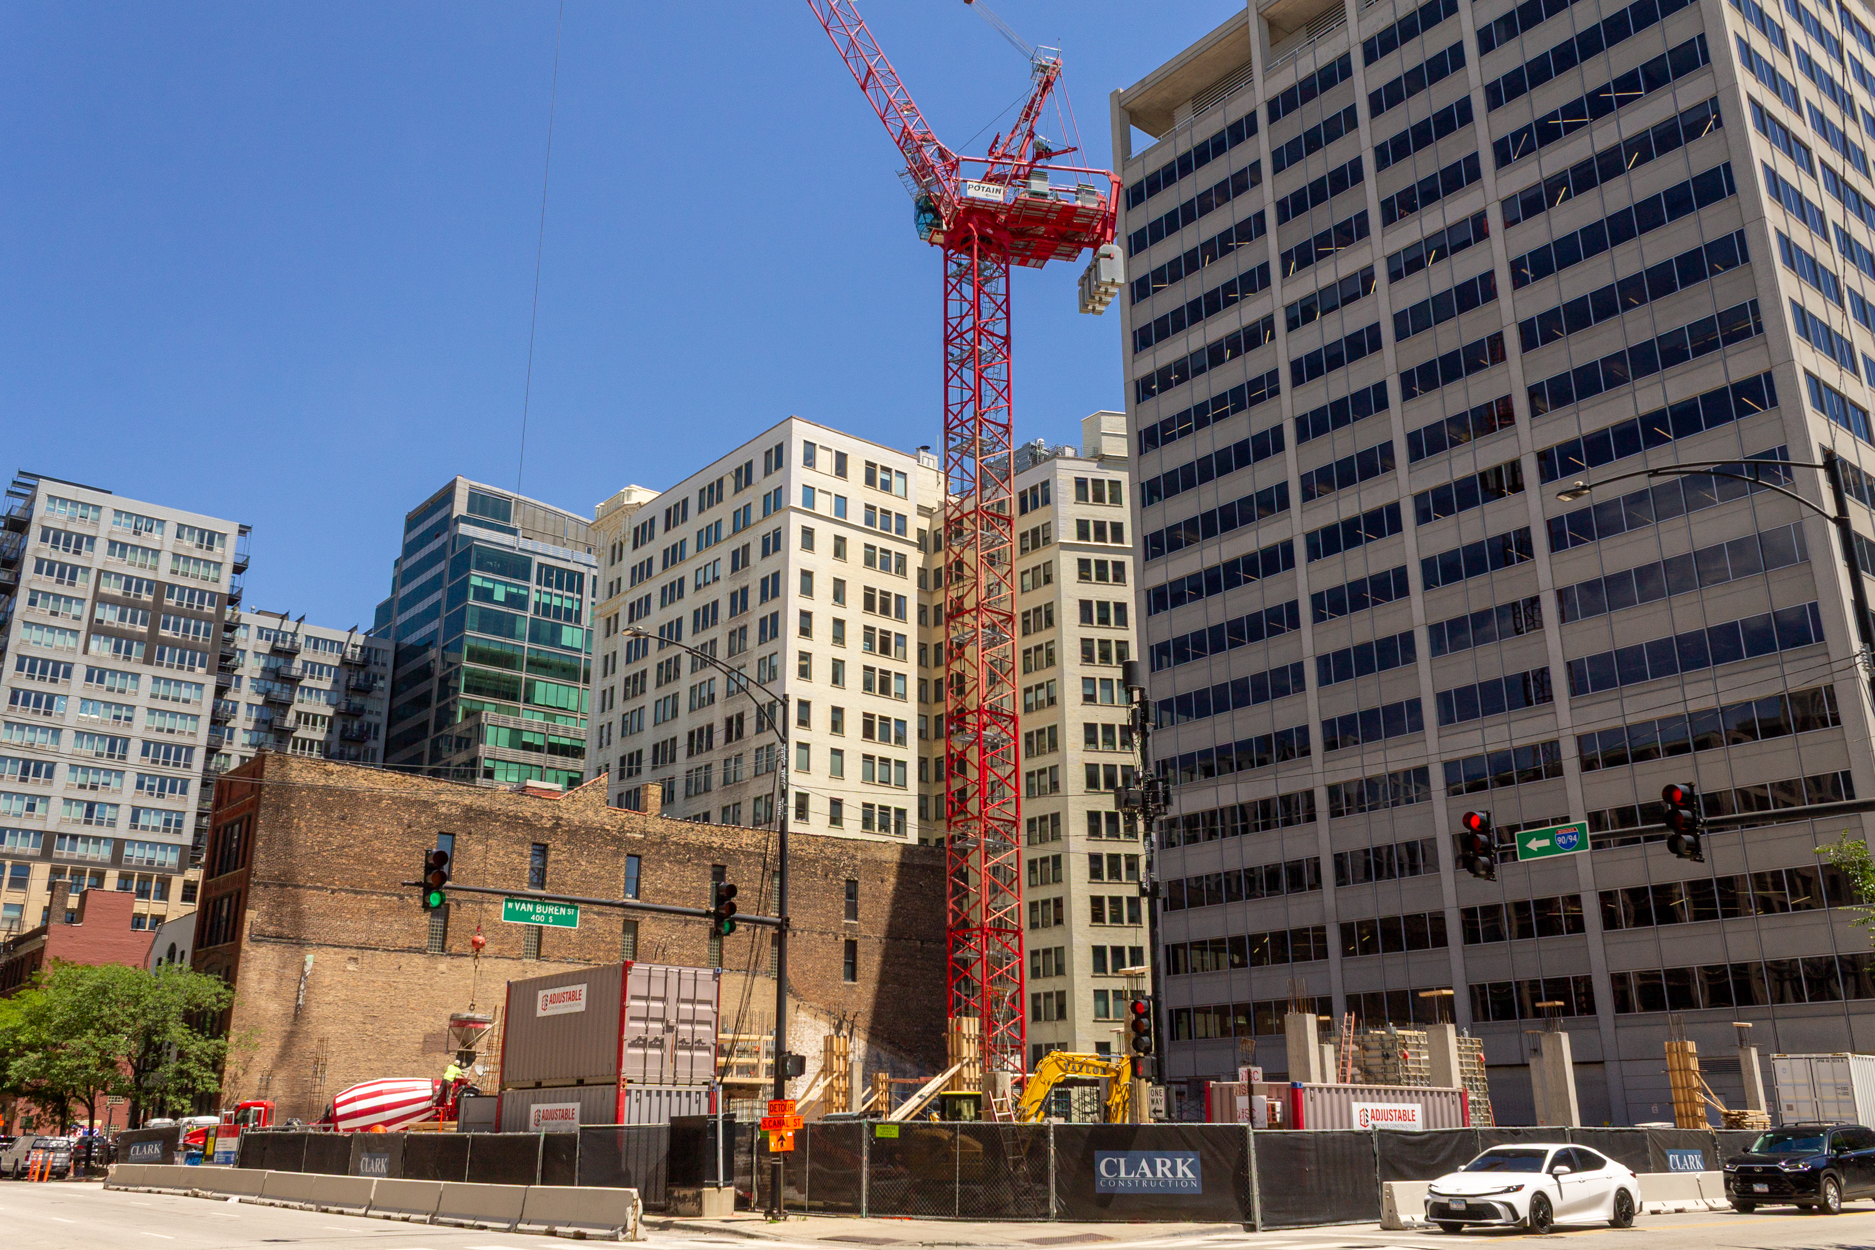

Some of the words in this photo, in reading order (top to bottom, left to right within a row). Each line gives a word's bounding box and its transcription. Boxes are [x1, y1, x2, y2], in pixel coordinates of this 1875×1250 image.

[968, 184, 1002, 195] POTAIN
[1556, 834, 1577, 845] 90/94
[515, 902, 533, 912] VAN
[536, 904, 566, 915] BUREN
[530, 914, 545, 922] 400
[548, 915, 553, 923] S
[549, 989, 582, 1004] ADJUSTABLE
[1064, 1063, 1107, 1075] TAYLOR
[1150, 1089, 1163, 1097] ONE
[770, 1103, 794, 1112] DETOUR
[541, 1108, 575, 1120] ADJUSTABLE
[1371, 1108, 1416, 1122] ADJUSTABLE
[793, 1118, 801, 1126] ST
[130, 1143, 161, 1156] CLARK
[360, 1157, 387, 1173] CLARK
[1100, 1157, 1196, 1178] CLARK
[1669, 1154, 1704, 1170] CLARK
[1100, 1180, 1197, 1188] CONSTRUCTION
